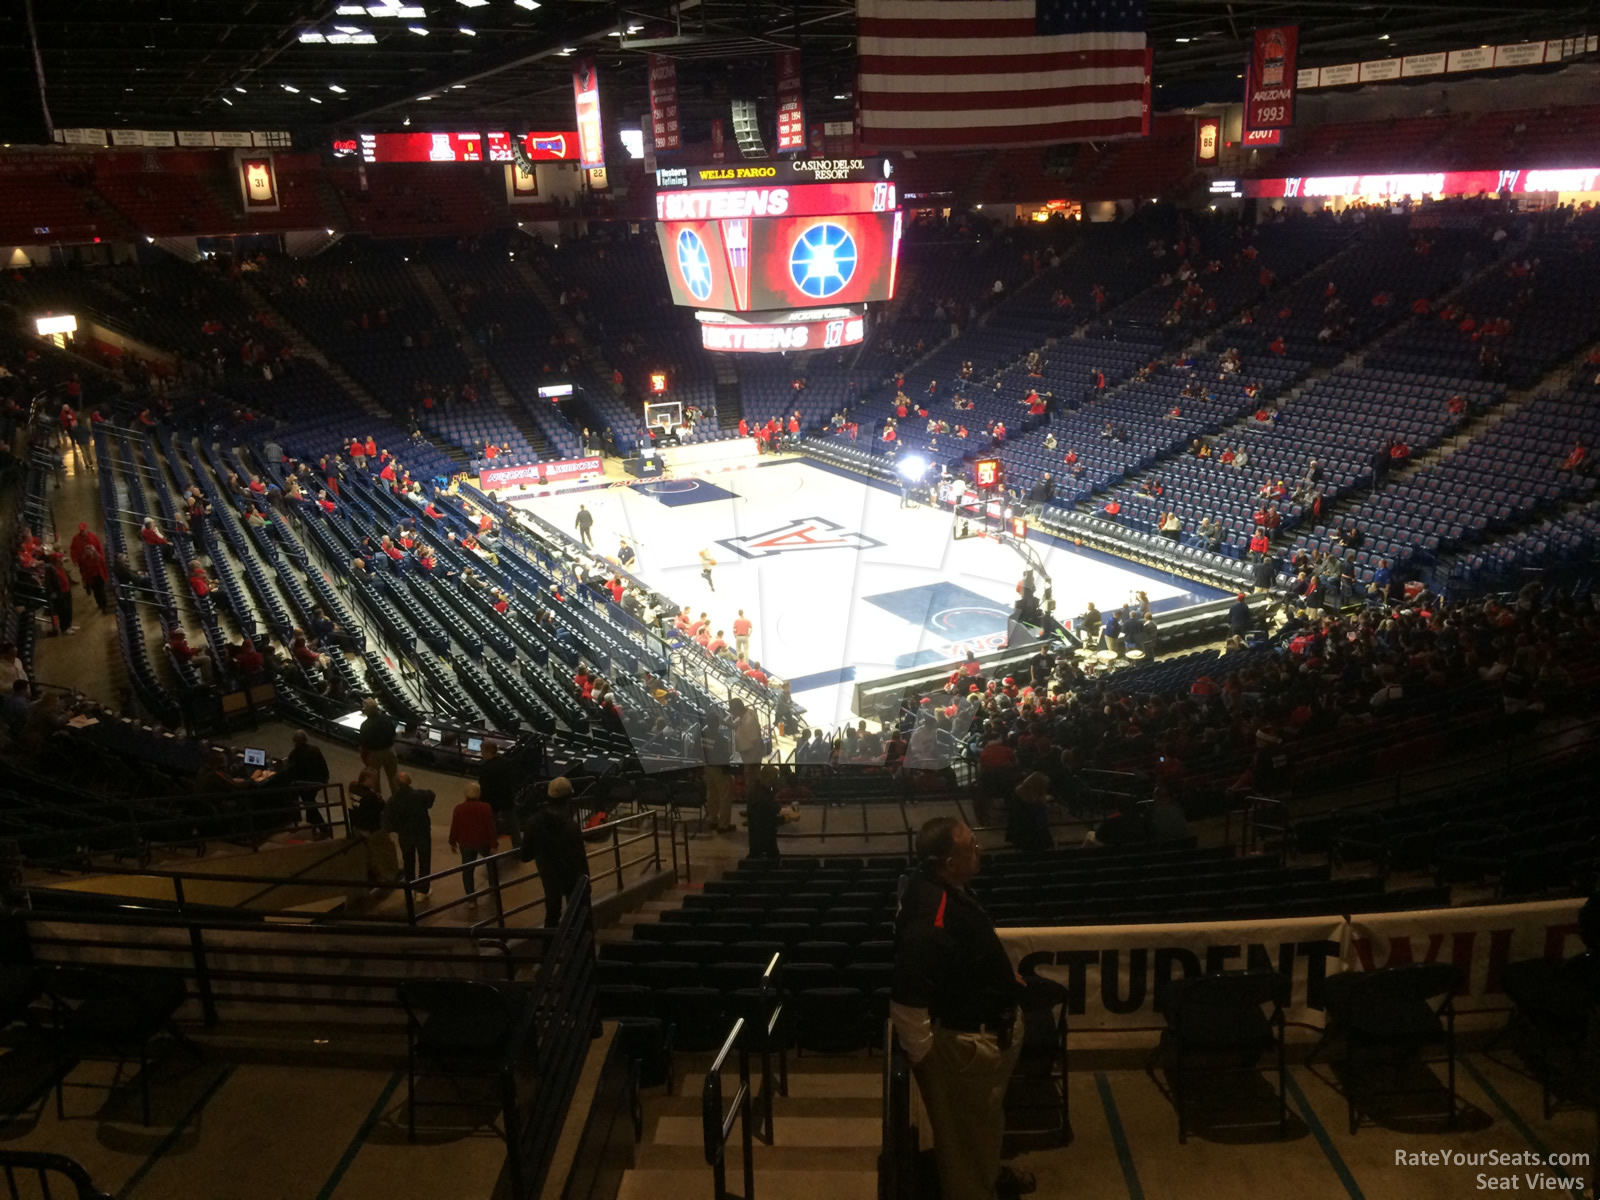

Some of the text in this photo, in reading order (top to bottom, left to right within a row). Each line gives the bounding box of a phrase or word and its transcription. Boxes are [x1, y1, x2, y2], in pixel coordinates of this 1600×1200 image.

[1252, 89, 1291, 102] ARIZONA
[1256, 106, 1284, 122] 1993
[793, 159, 865, 172] CASINO DEL SOL
[594, 169, 603, 178] 22
[699, 167, 776, 180] WELLS FARGO
[815, 169, 849, 180] RESORT
[255, 179, 265, 188] 31
[666, 188, 789, 220] SIXTEENS
[872, 182, 888, 212] 17
[825, 321, 843, 349] 17
[487, 460, 600, 483] ARIZONA WILDCATS
